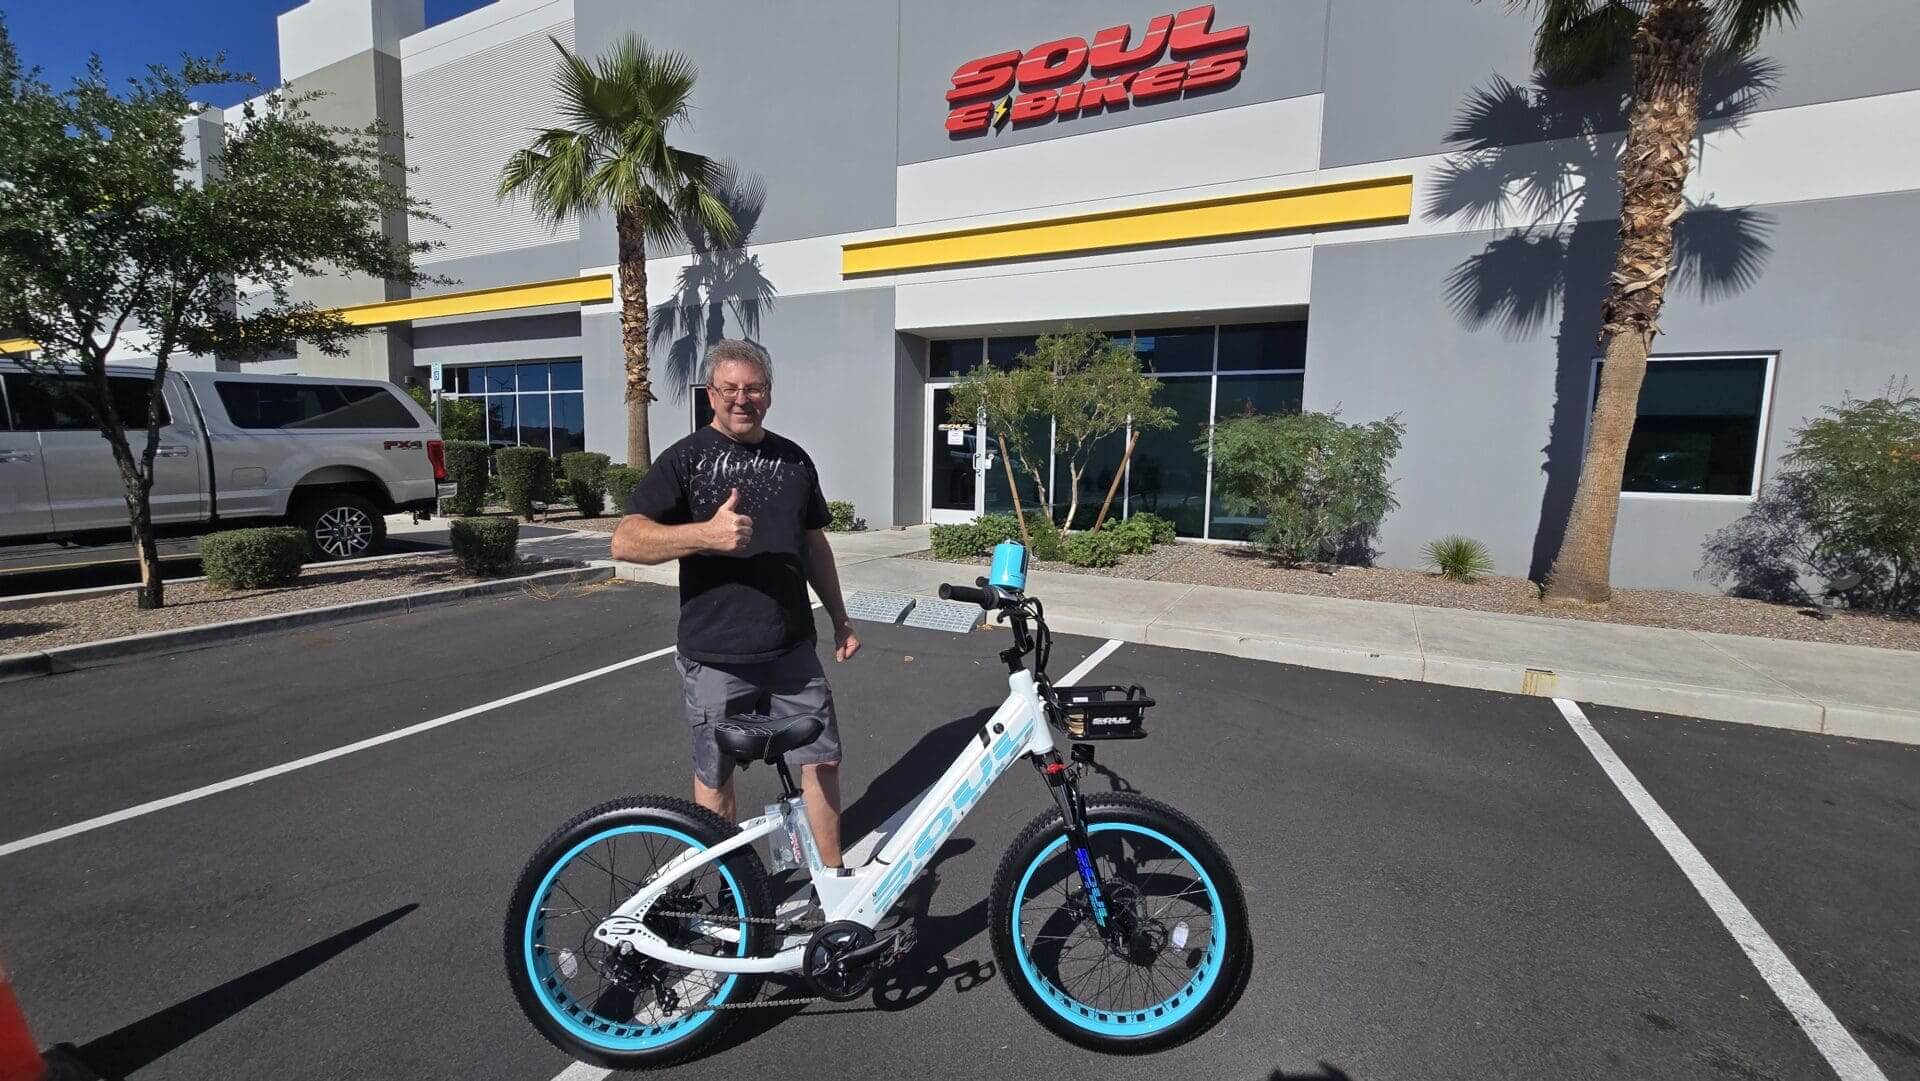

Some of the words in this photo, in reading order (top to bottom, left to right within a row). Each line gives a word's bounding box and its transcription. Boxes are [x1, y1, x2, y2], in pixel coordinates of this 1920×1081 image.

[946, 4, 1250, 102] SOUL
[696, 450, 782, 484] Hurley
[872, 718, 1034, 914] SOUL
